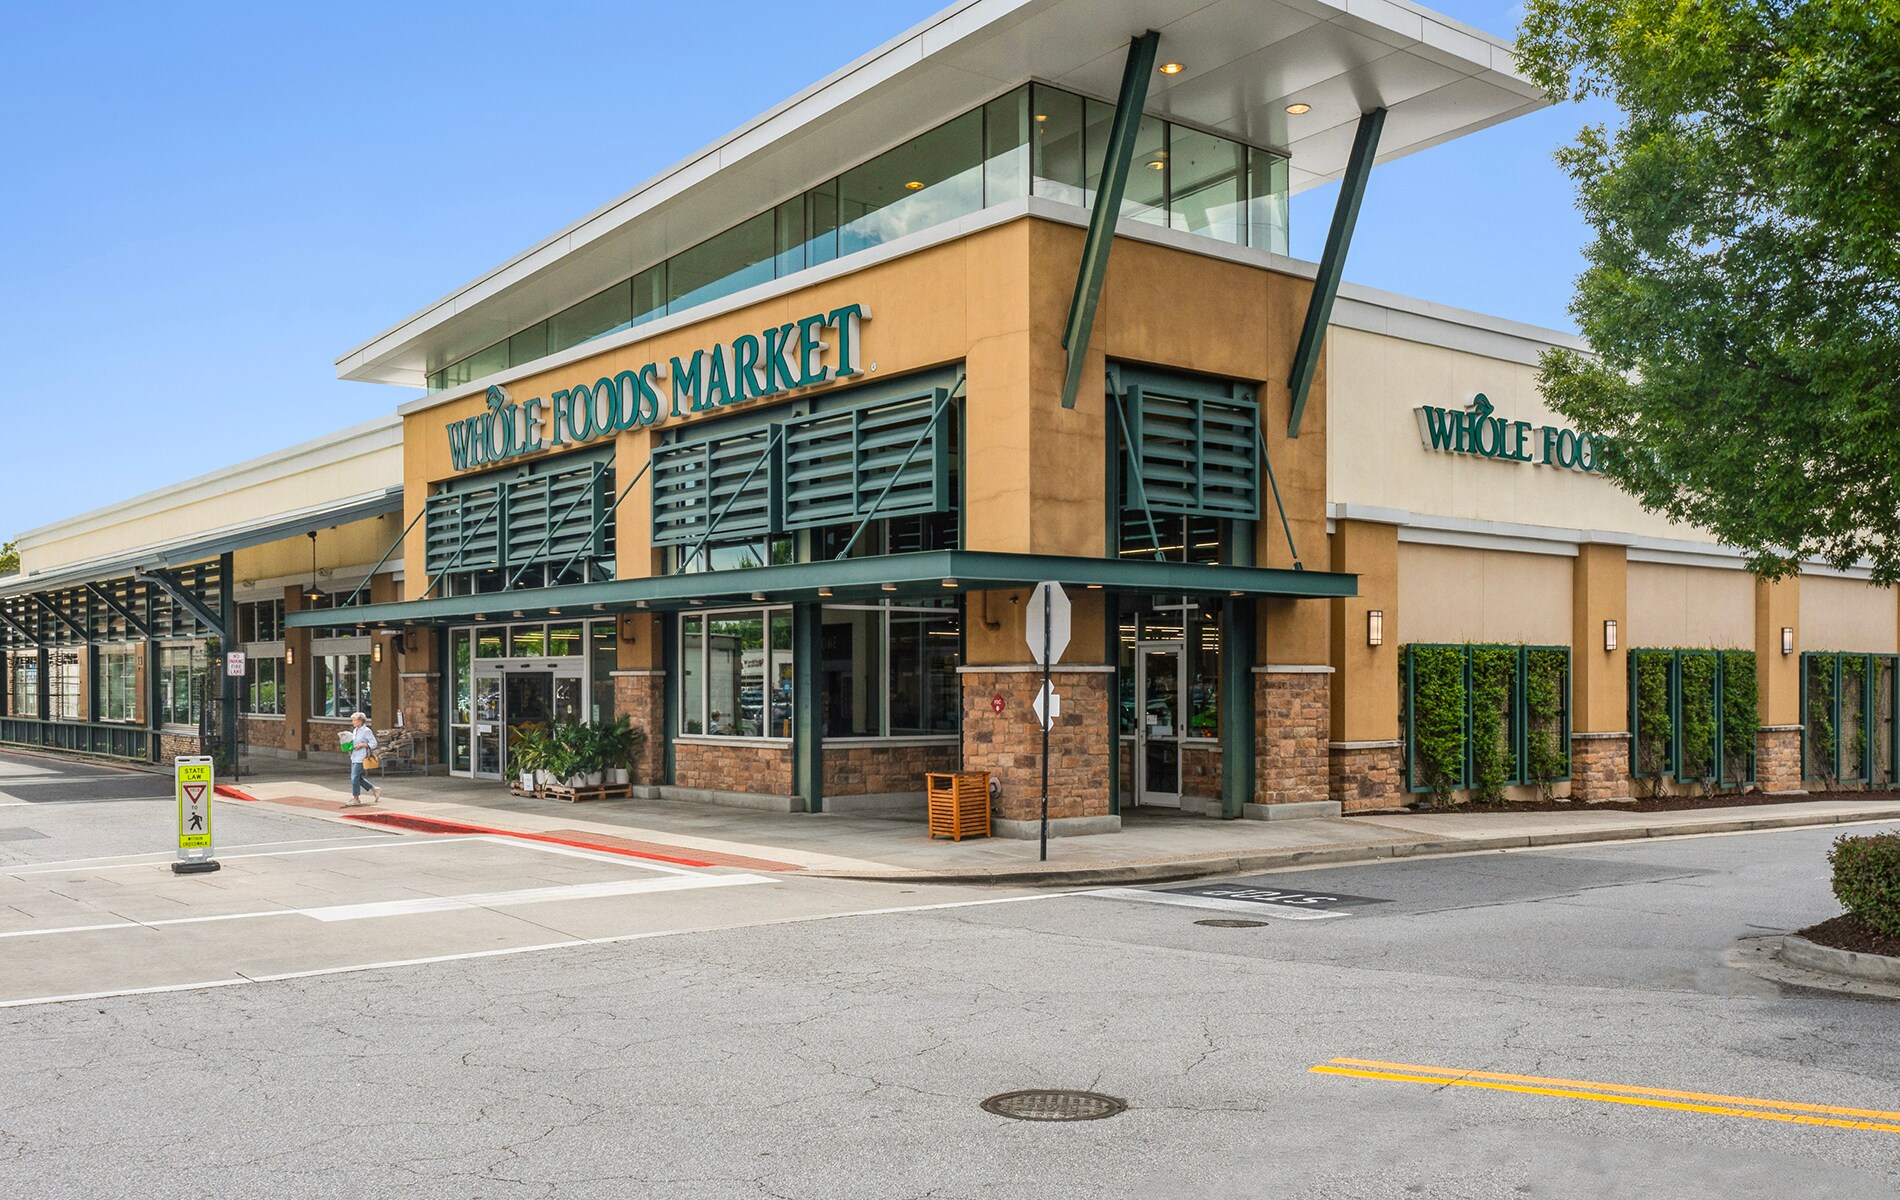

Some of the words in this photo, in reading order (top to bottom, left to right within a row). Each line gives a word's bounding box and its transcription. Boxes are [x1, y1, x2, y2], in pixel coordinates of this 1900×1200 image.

[446, 384, 549, 471] WHOLE
[551, 362, 666, 446] FOODS
[669, 303, 869, 418] MARKET
[1420, 392, 1533, 462] WHOLE
[1541, 425, 1618, 473] FOO
